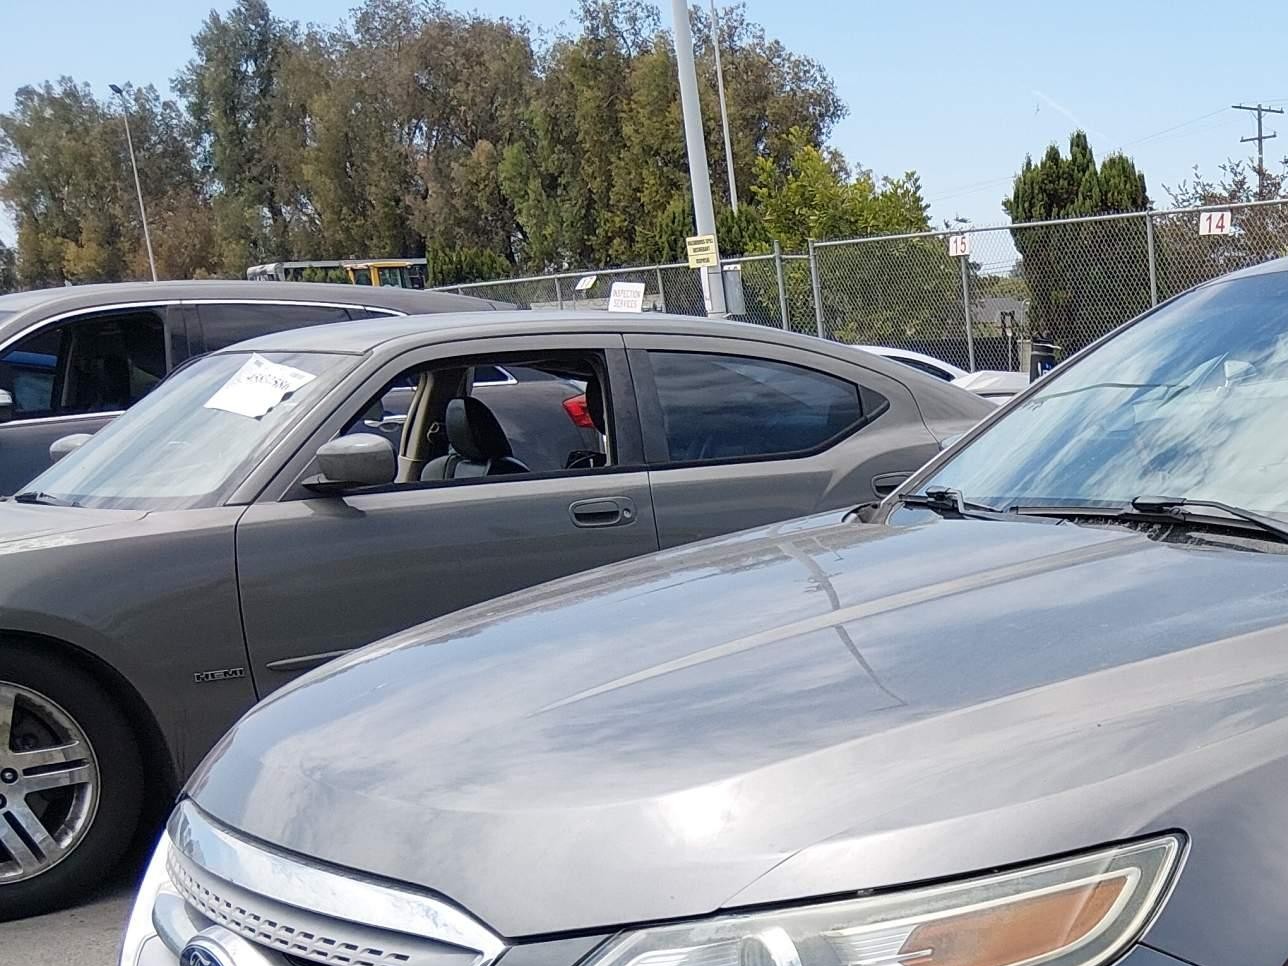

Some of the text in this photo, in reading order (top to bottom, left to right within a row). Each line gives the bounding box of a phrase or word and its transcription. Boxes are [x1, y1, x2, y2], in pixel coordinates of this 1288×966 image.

[1206, 213, 1225, 233] 14
[953, 236, 966, 254] 15
[194, 667, 245, 683] HEMI
